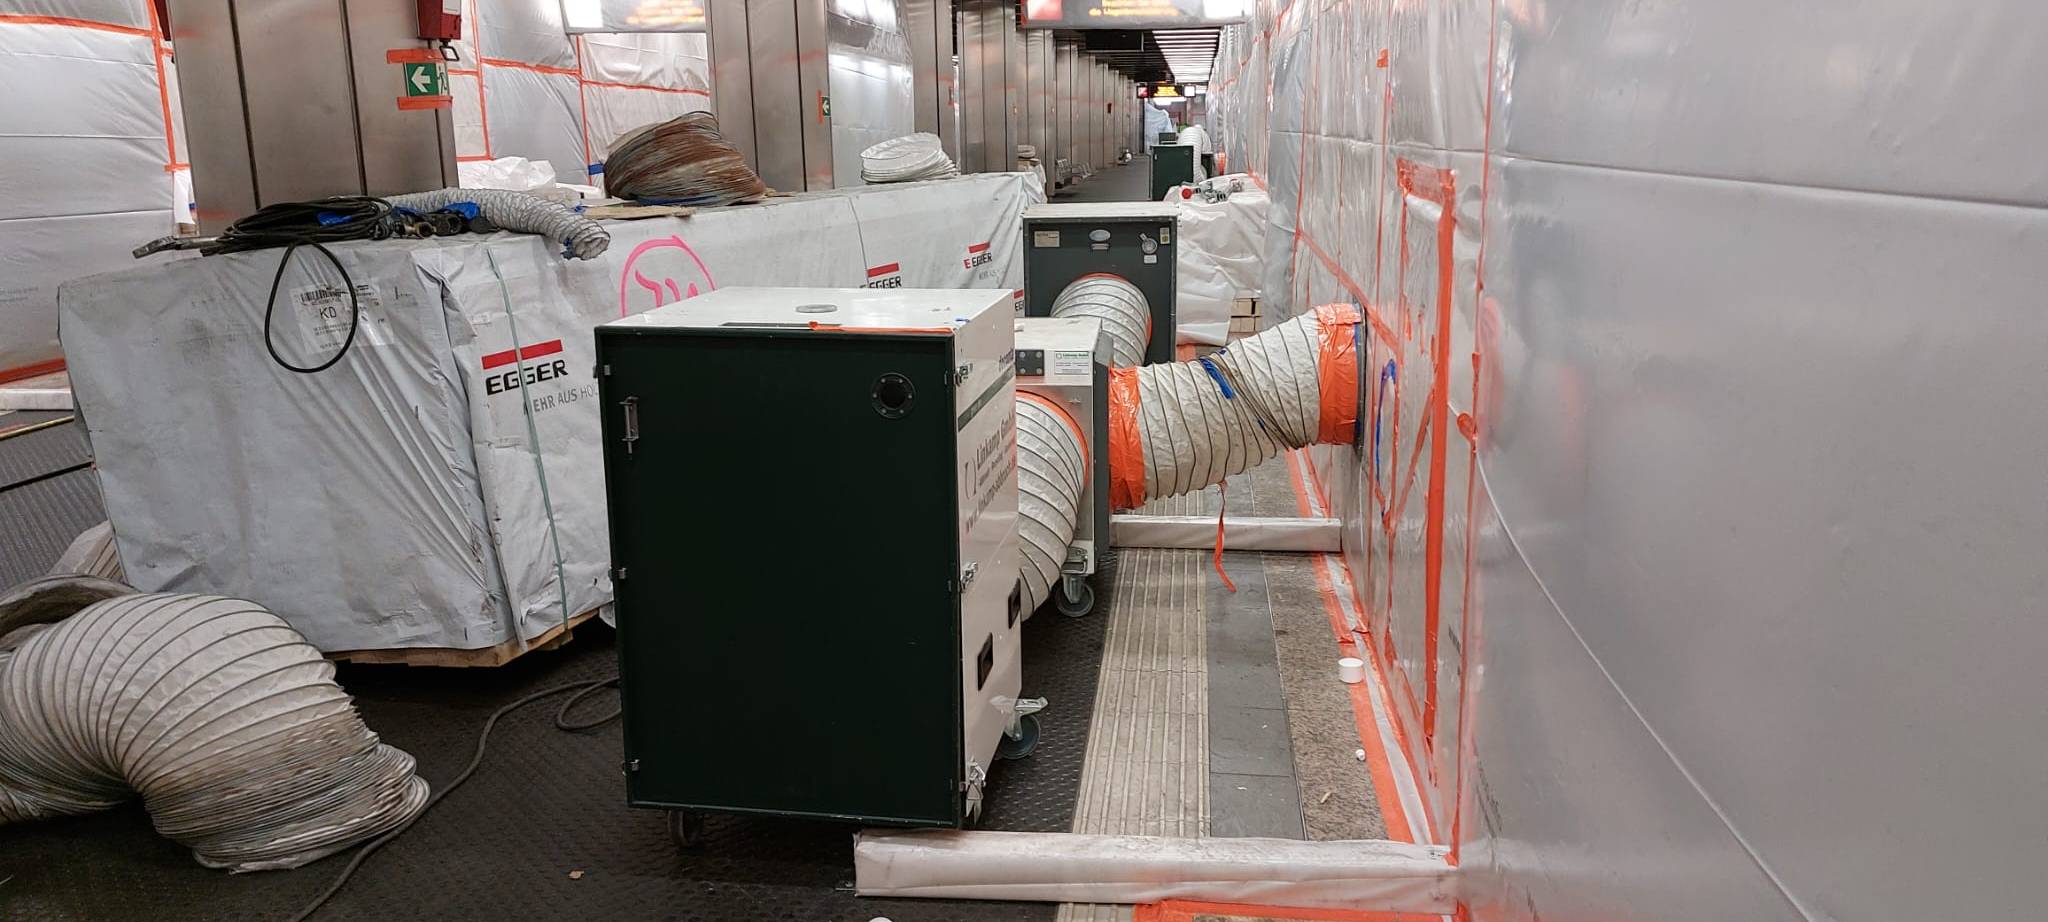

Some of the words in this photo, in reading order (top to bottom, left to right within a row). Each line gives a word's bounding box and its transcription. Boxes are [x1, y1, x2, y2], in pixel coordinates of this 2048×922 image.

[319, 306, 337, 319] KD
[485, 359, 569, 396] EGGER
[557, 387, 578, 405] AUS
